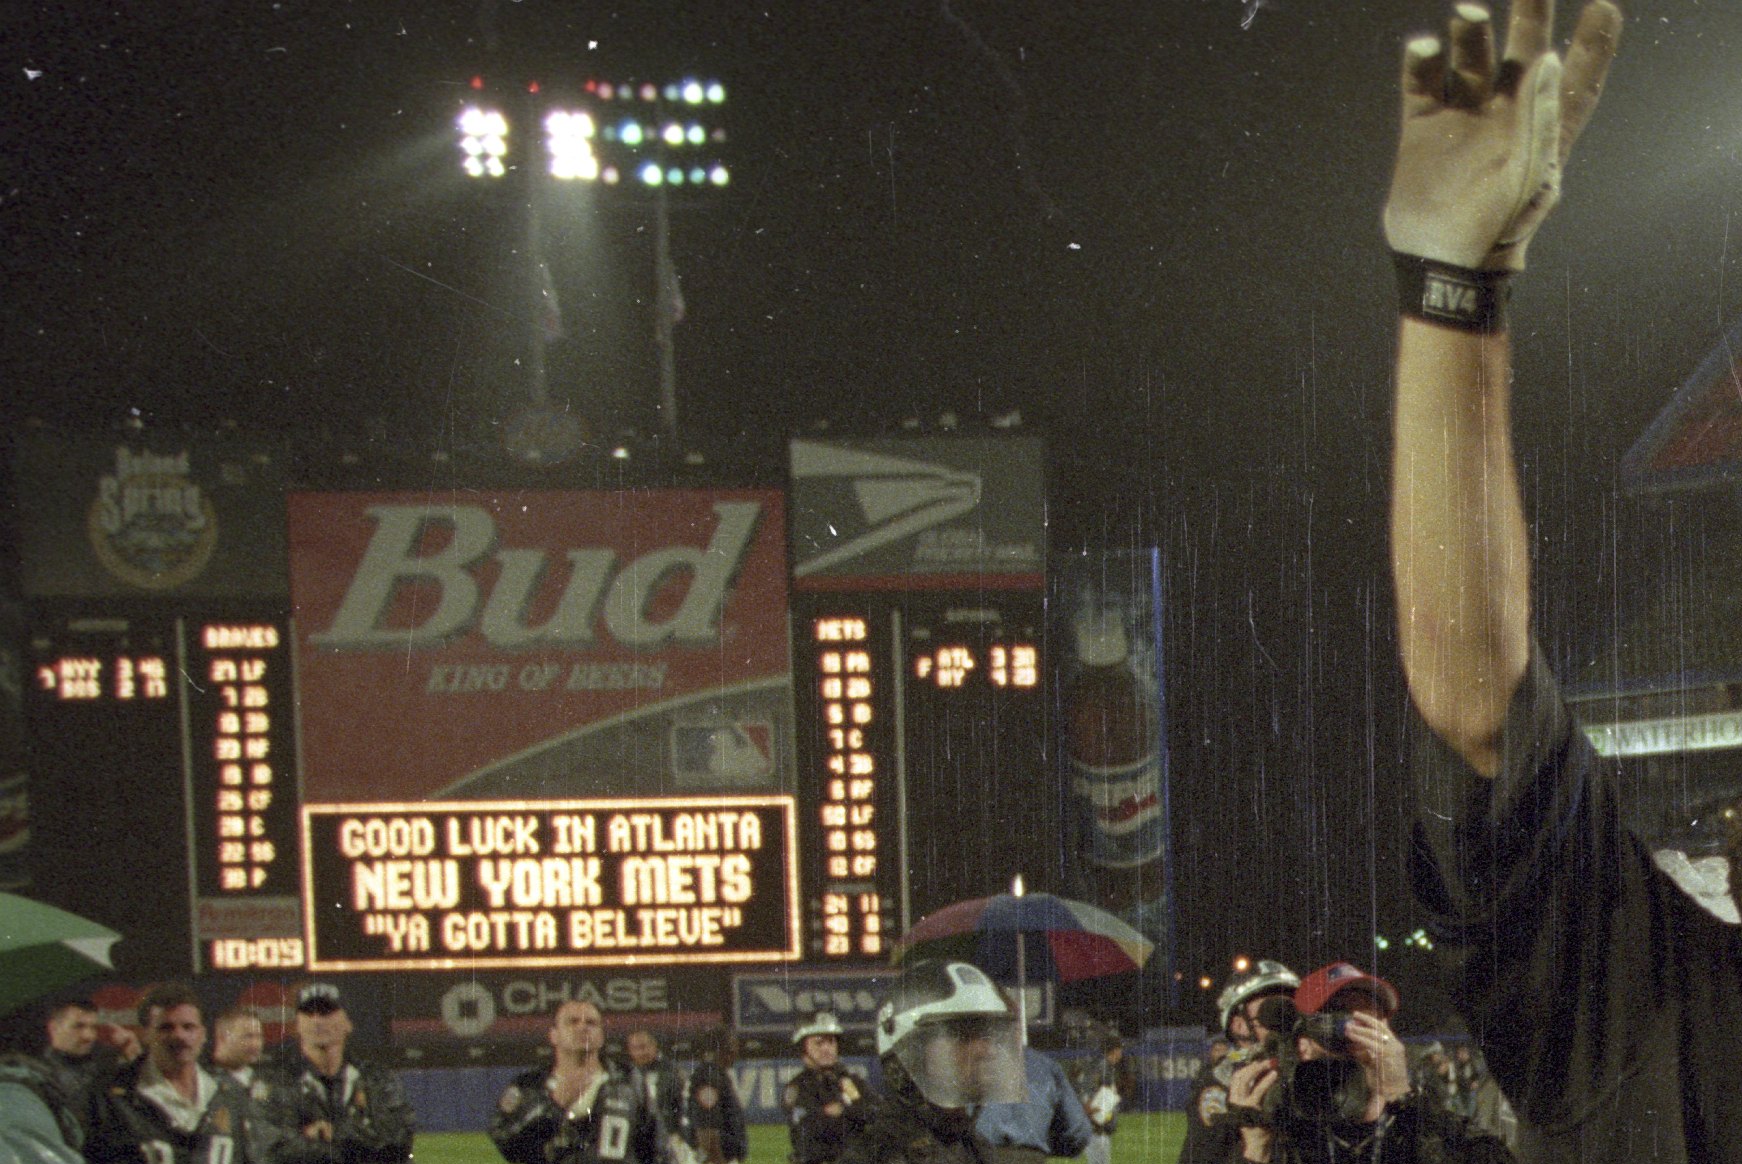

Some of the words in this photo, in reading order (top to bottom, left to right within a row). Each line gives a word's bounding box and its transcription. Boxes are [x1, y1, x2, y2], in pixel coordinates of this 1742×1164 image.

[308, 502, 763, 648] Bud
[341, 818, 433, 857] GOOD
[448, 816, 539, 856] LUCK
[553, 814, 596, 853] IN
[608, 812, 761, 852] ATLANTA
[354, 860, 459, 909] NEW
[479, 858, 602, 907] YORK
[622, 854, 752, 904] METS
[366, 914, 429, 952] "YA
[442, 911, 557, 949] GOTTA
[570, 907, 741, 947] BELIEVE"
[213, 937, 305, 968] 10:09
[502, 977, 668, 1012] CHASE
